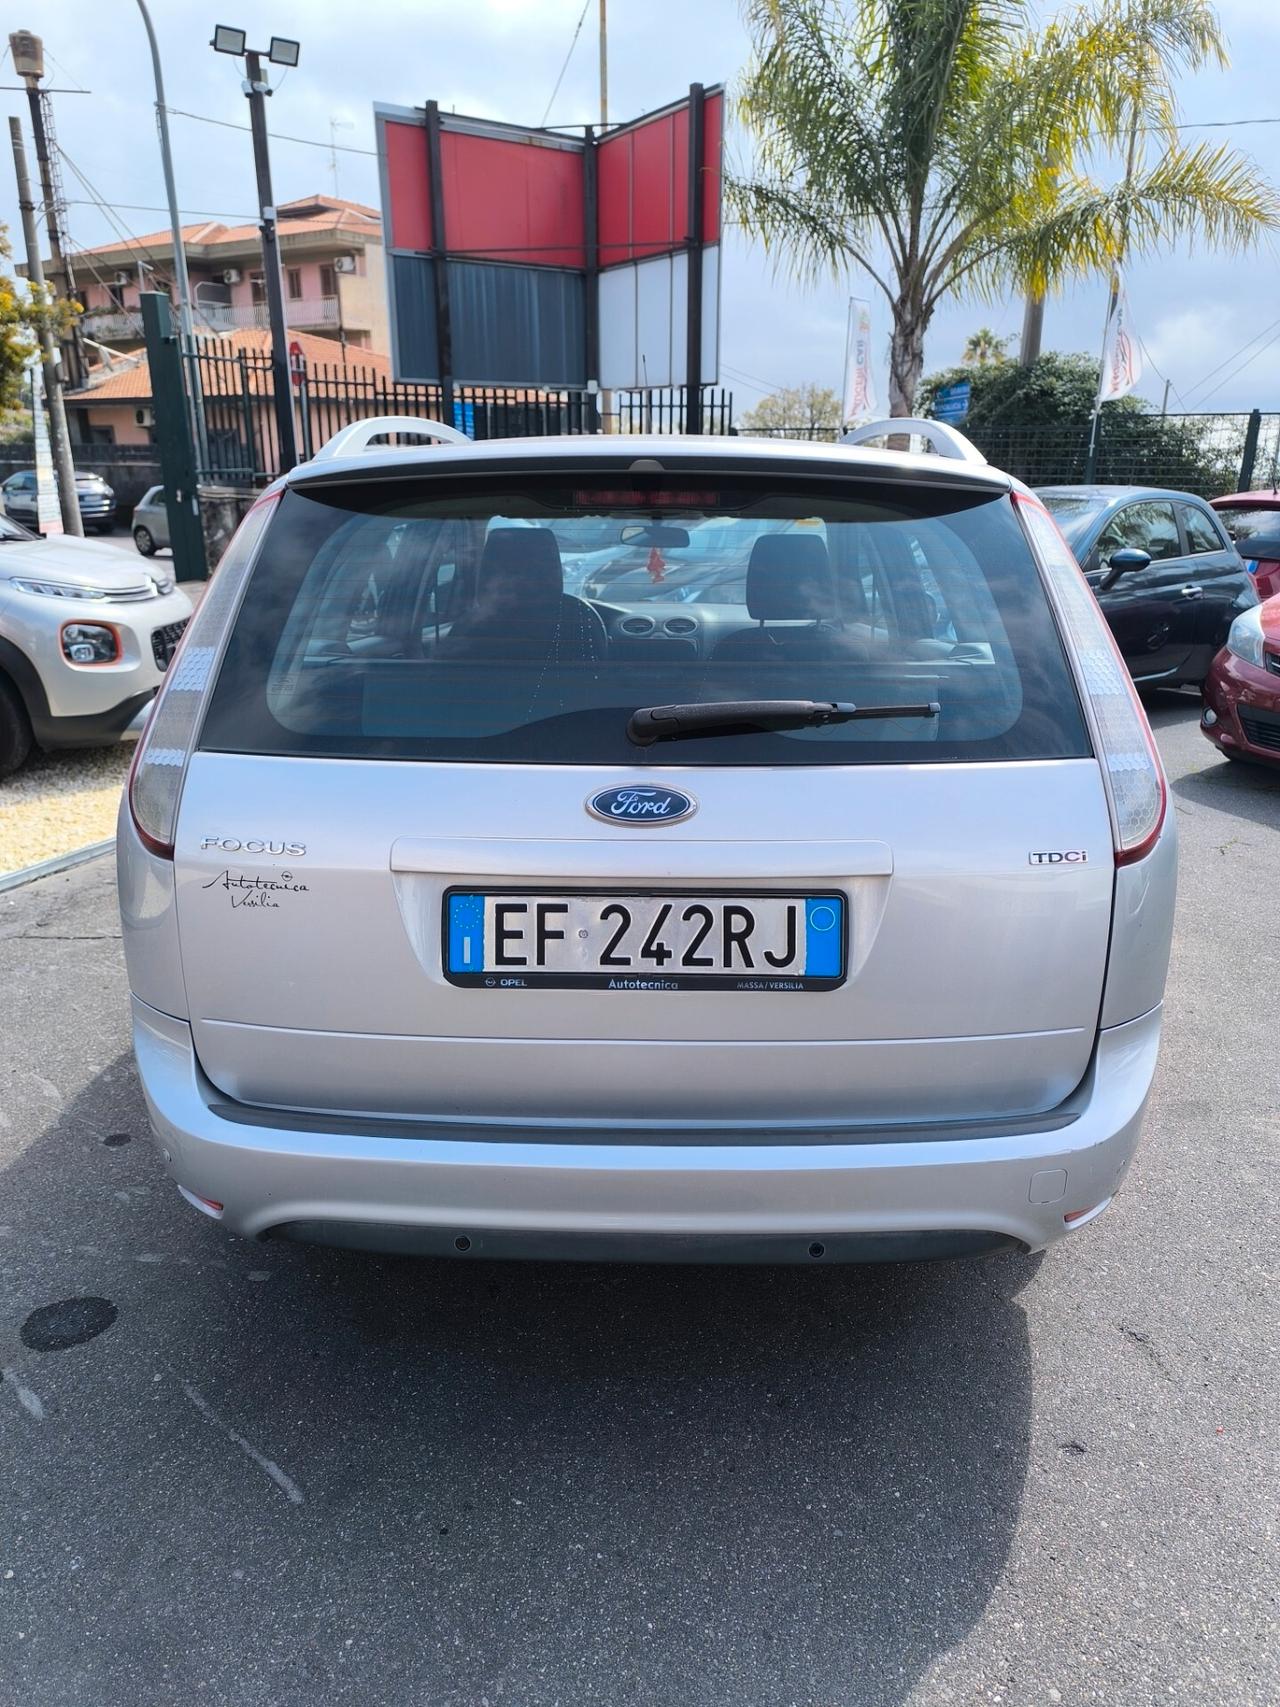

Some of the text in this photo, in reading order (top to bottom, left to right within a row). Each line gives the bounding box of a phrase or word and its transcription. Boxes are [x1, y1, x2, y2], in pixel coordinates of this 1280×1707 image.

[611, 791, 671, 814] Ford
[200, 836, 307, 857] FOCUS
[1032, 851, 1087, 863] TDCi
[202, 870, 309, 892] Autotecnica
[495, 903, 569, 966] EF
[600, 904, 797, 968] 242RJ
[500, 979, 527, 987] OPEL
[608, 979, 679, 990] Autotecnica
